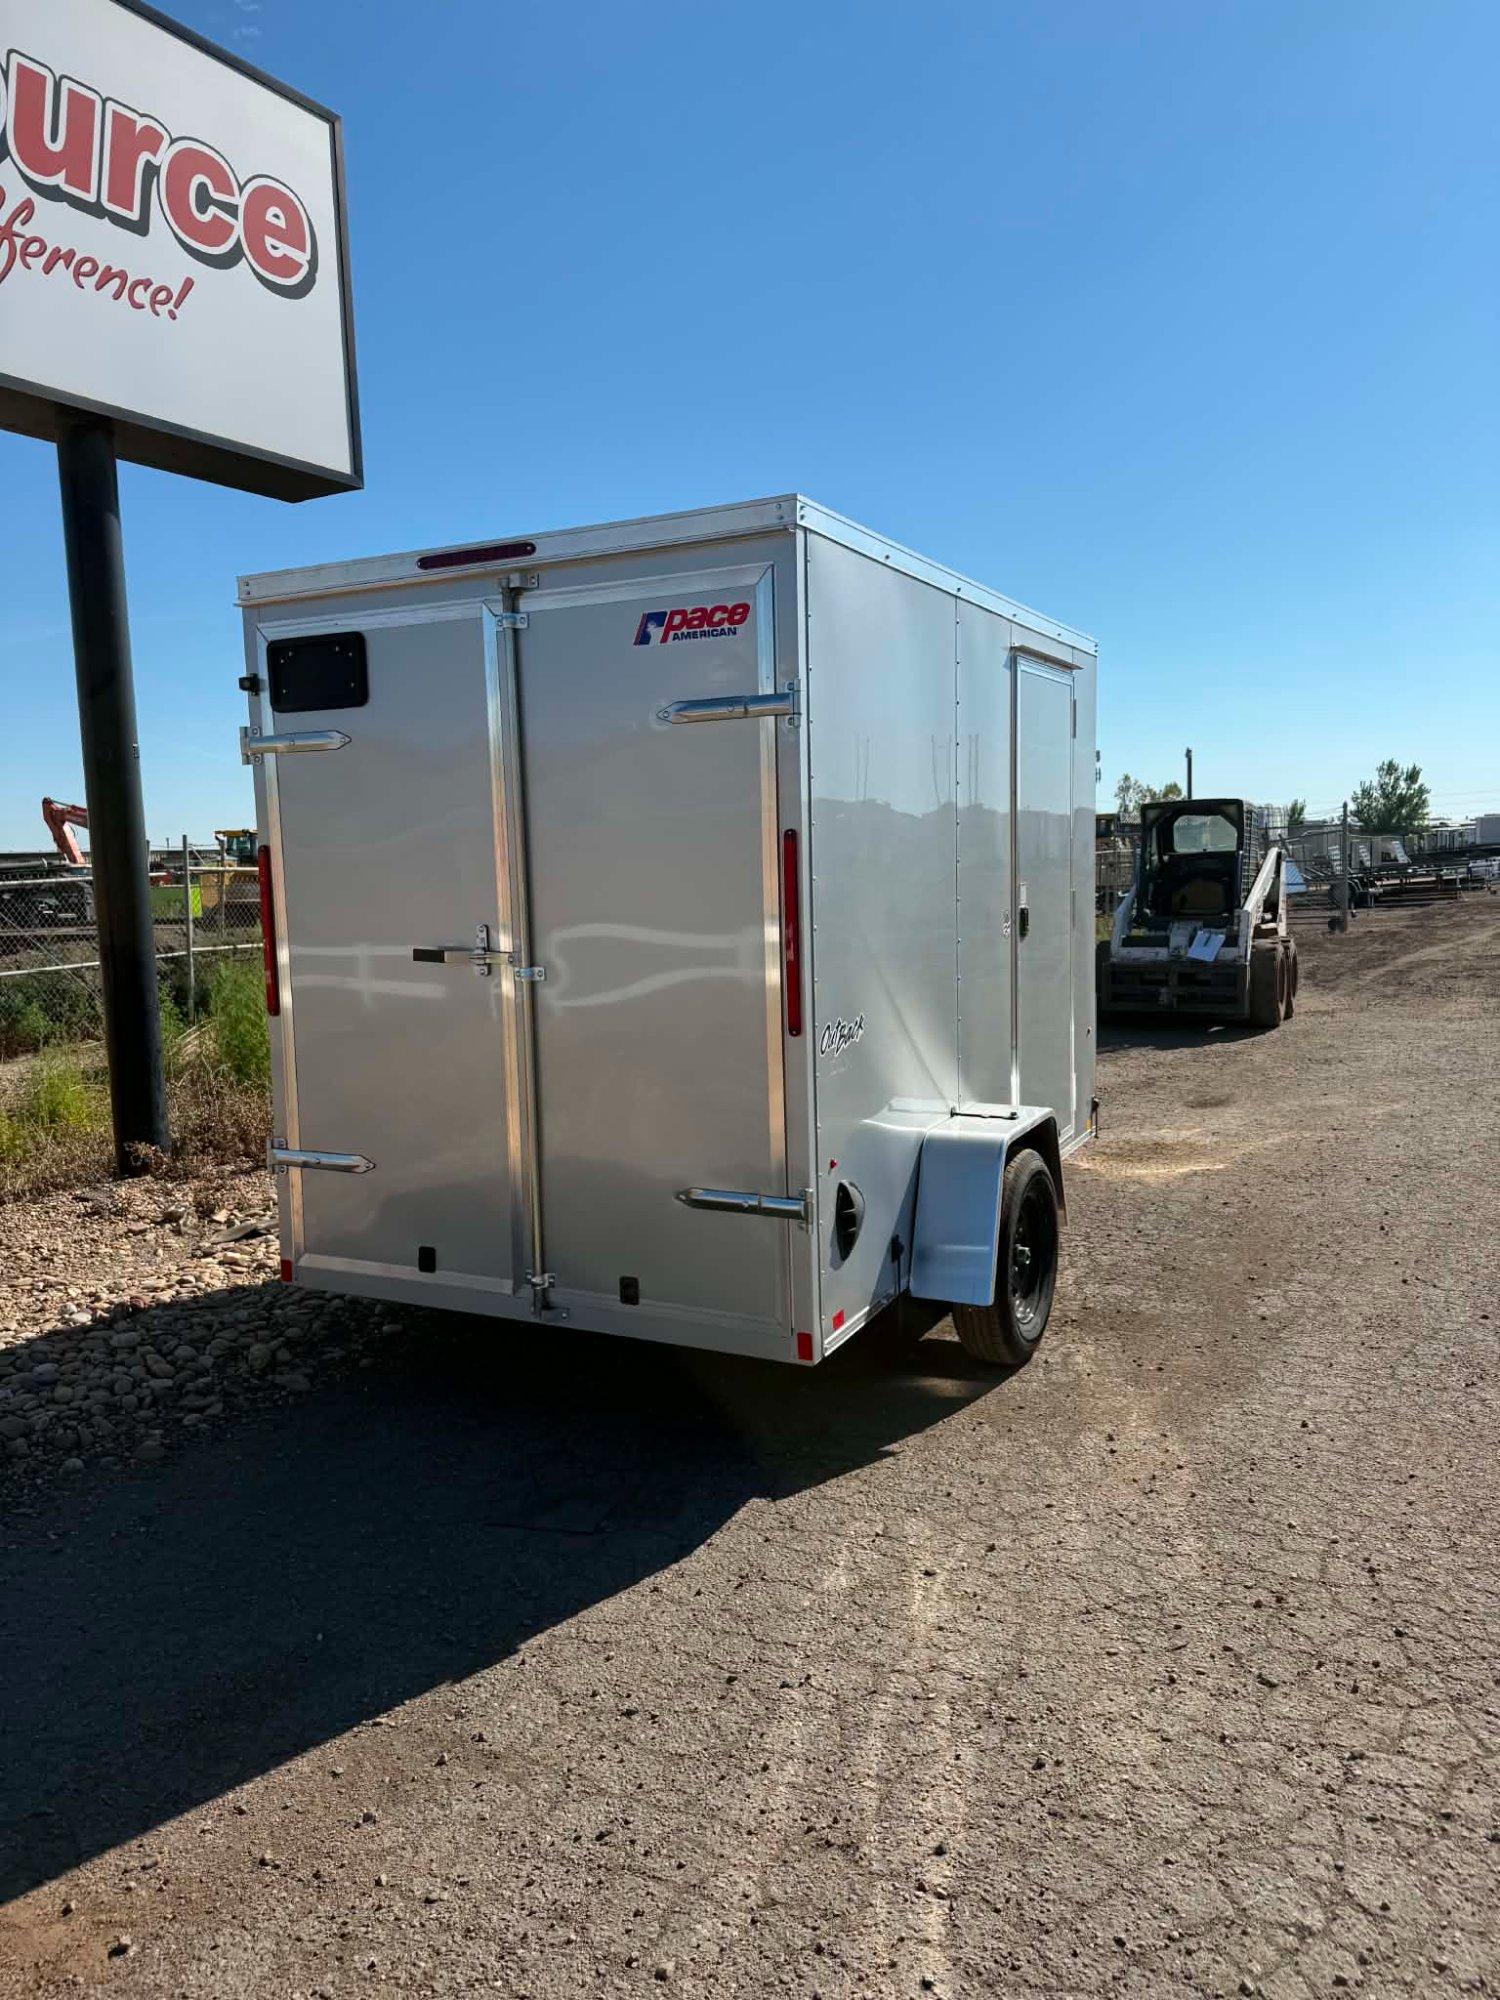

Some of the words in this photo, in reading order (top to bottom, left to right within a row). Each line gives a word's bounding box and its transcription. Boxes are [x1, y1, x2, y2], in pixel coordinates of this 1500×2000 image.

[0, 48, 319, 300] urce
[0, 185, 195, 320] ference!
[671, 627, 738, 642] AMERICAN
